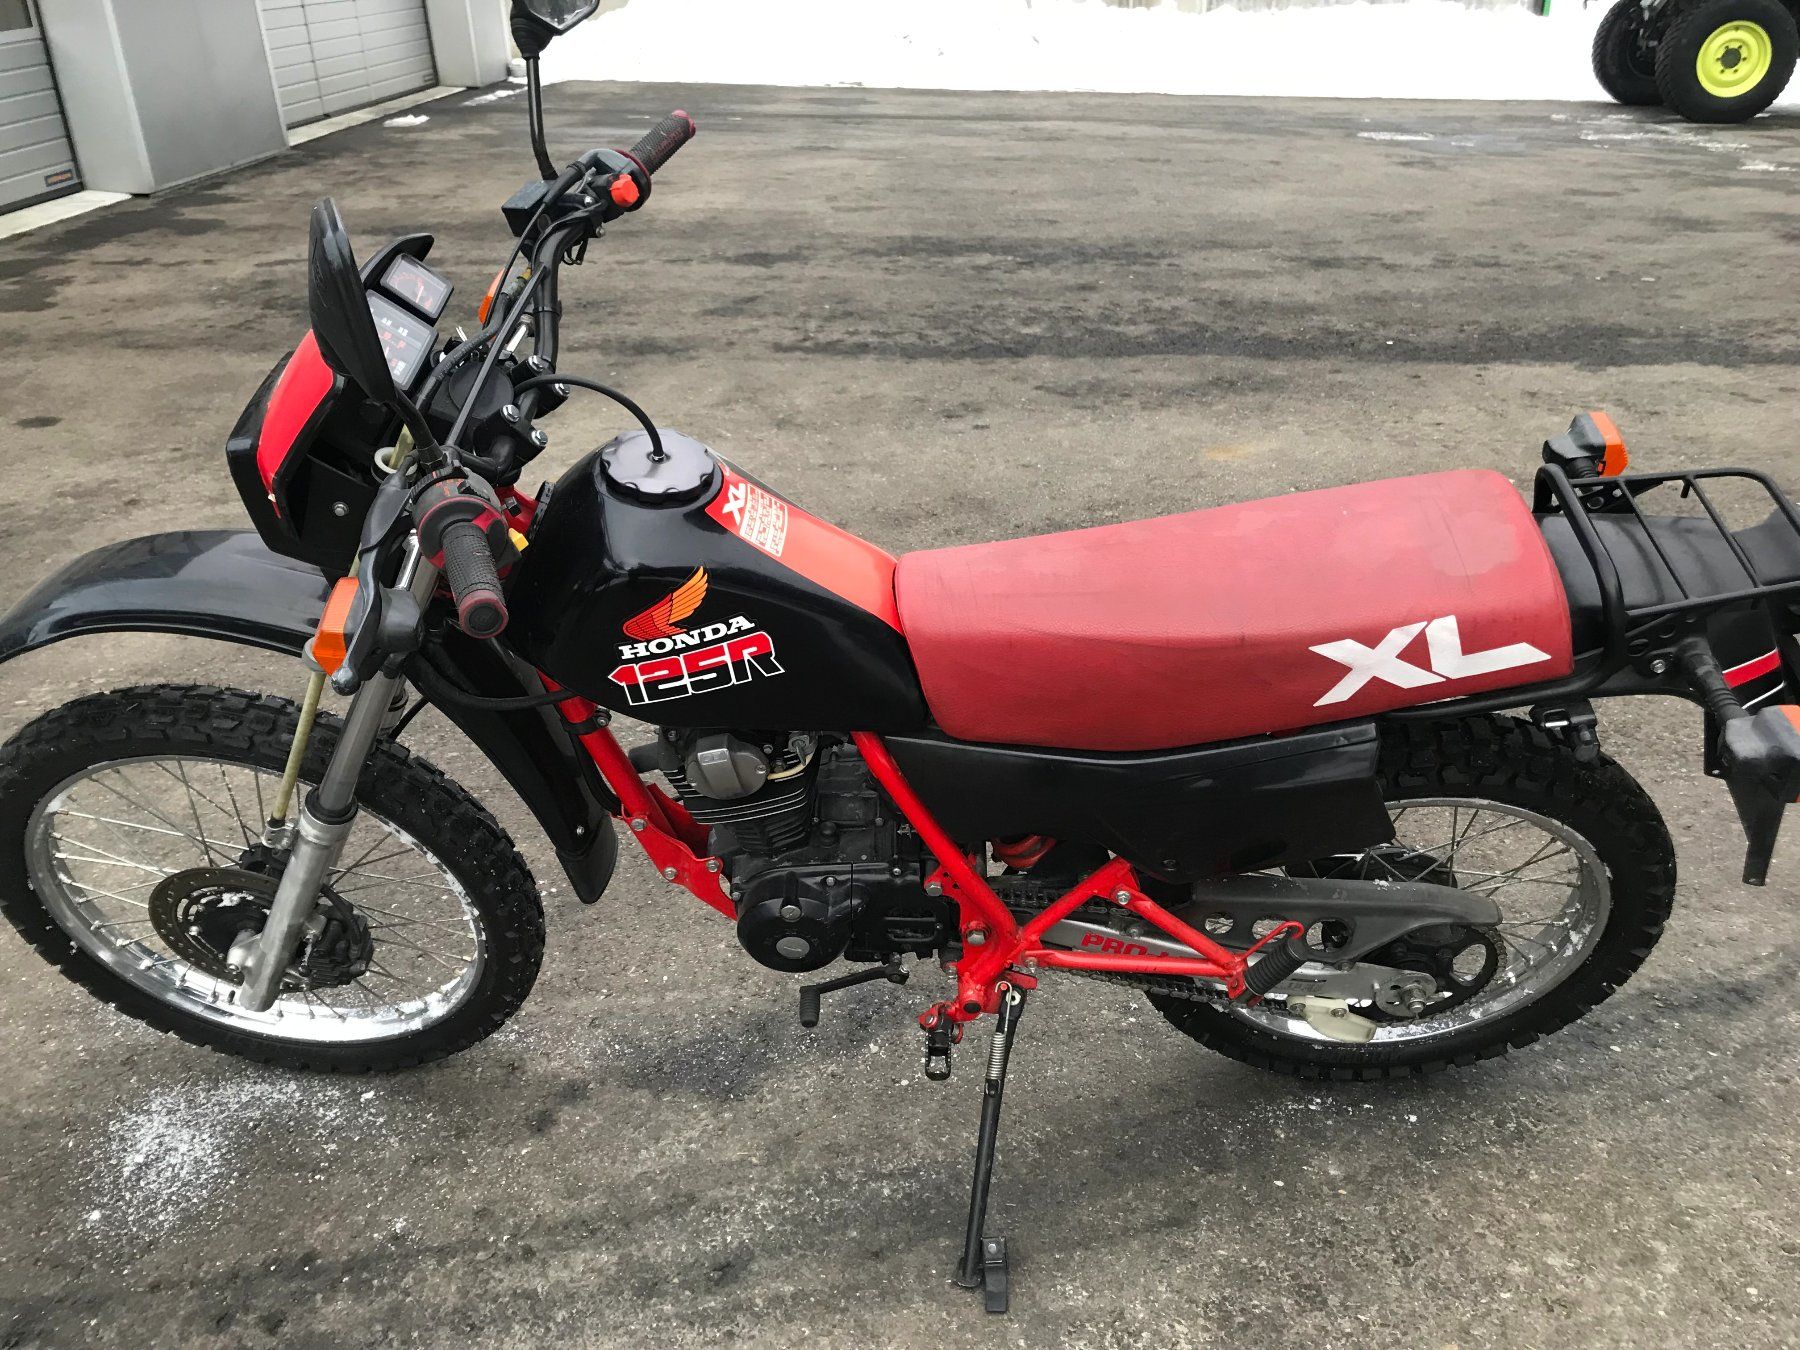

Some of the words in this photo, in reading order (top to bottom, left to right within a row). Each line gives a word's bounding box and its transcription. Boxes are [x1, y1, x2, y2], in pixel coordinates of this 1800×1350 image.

[607, 631, 786, 706] 125R
[618, 615, 756, 660] HONDA
[1308, 614, 1552, 707] XL
